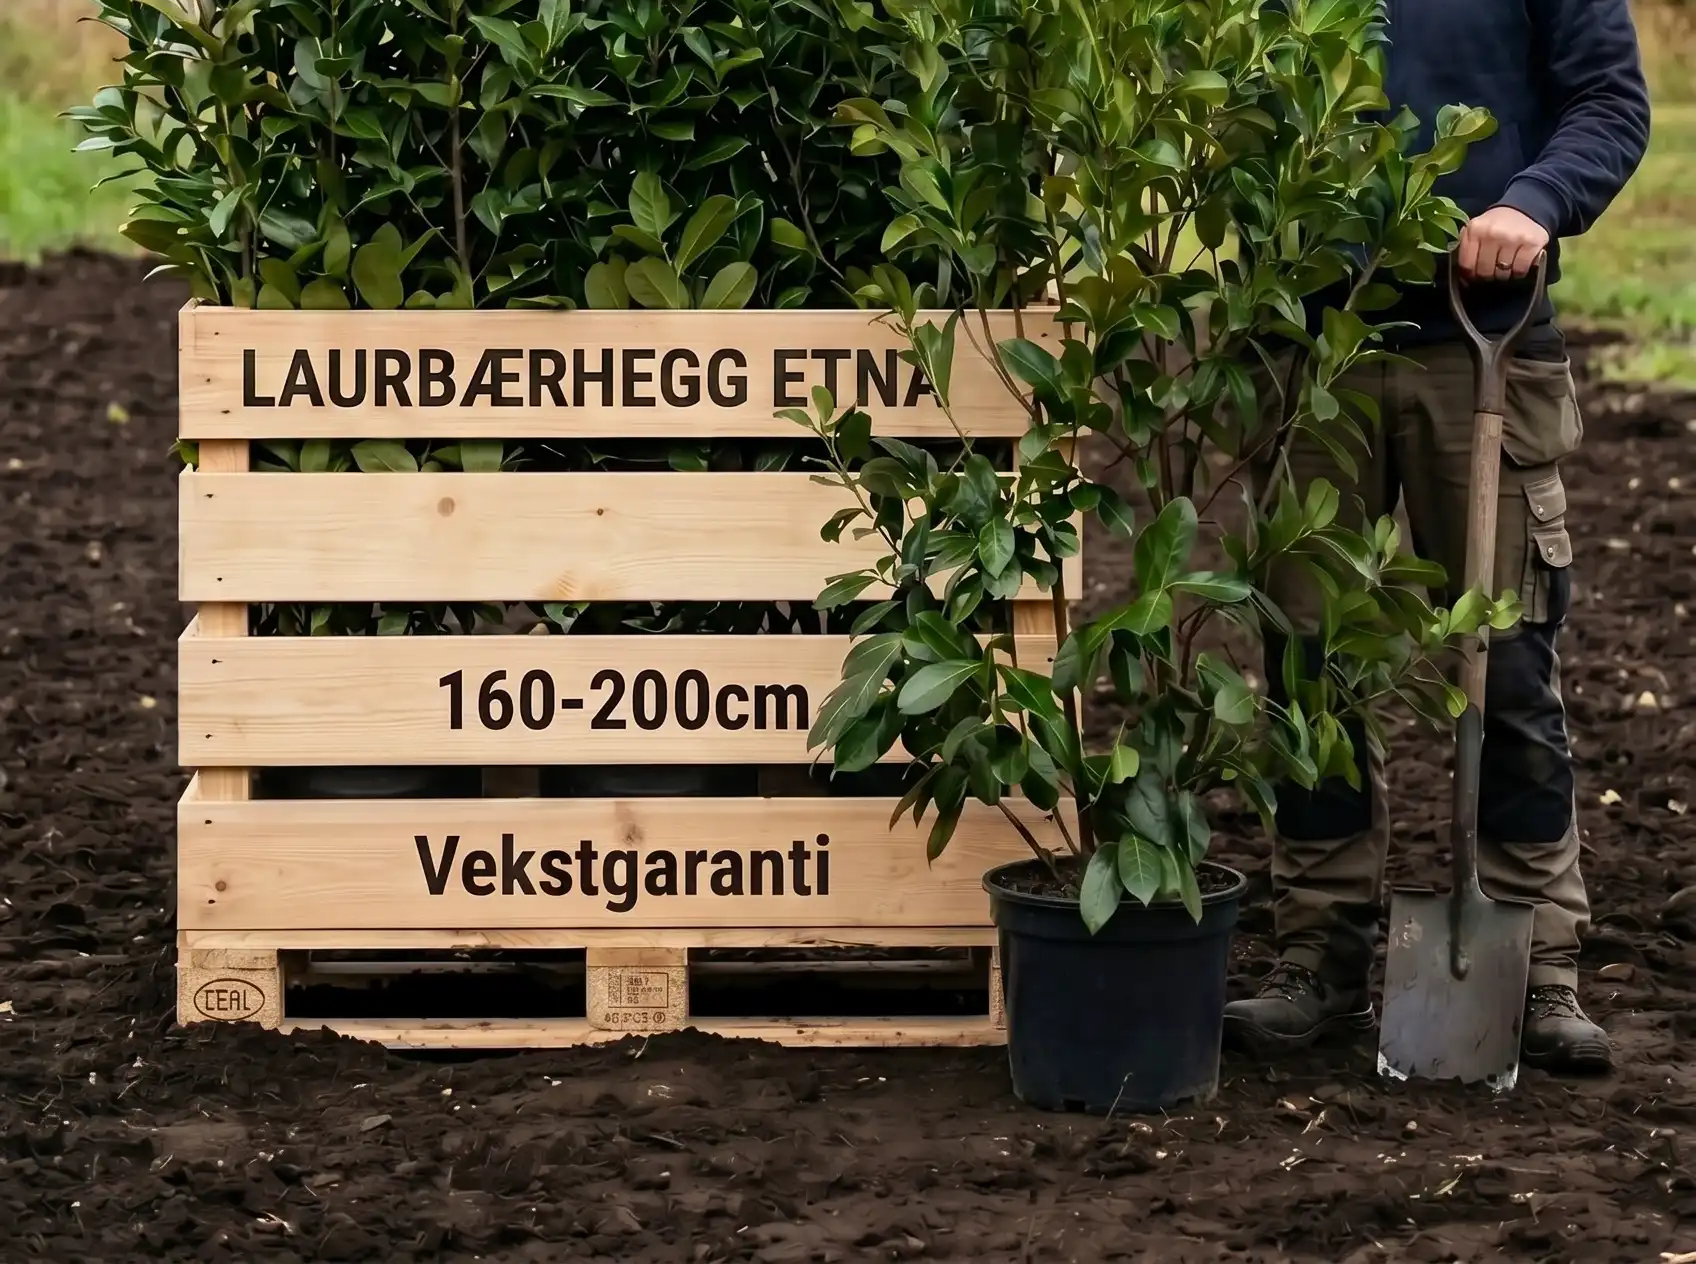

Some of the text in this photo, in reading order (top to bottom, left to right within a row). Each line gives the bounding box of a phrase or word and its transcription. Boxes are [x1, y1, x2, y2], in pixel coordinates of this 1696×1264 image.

[243, 348, 748, 408] LAURBÆRHEGG
[439, 669, 810, 731] 160-200cm
[413, 833, 830, 913] Vekstgaranti
